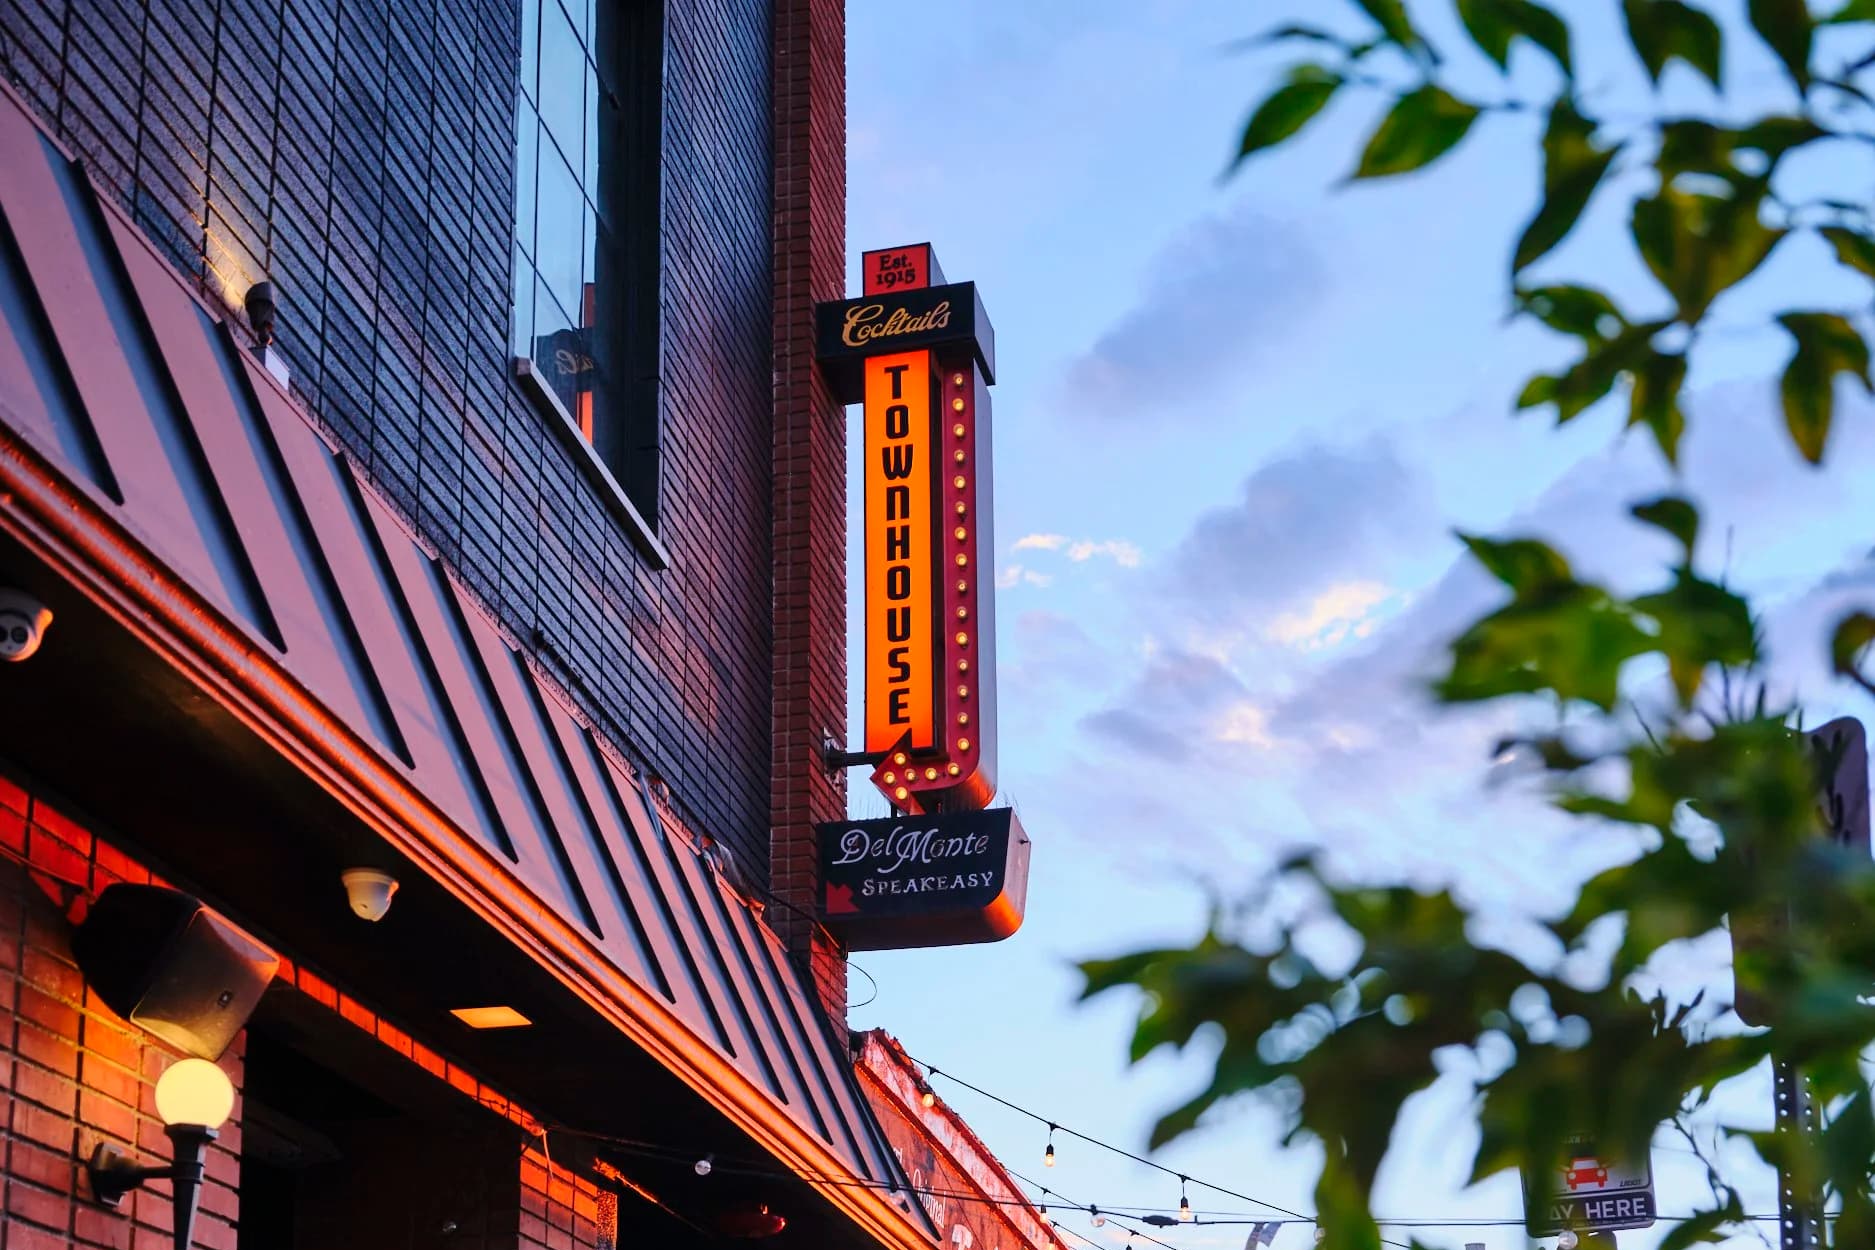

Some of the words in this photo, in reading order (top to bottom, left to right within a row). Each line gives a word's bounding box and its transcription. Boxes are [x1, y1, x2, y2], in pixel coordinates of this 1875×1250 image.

[879, 253, 913, 271] Est.
[876, 267, 916, 289] 1915
[842, 301, 951, 347] Cocktails
[882, 364, 914, 725] TOWNHOUSE
[861, 871, 994, 897] SPEAKEASY
[1584, 1198, 1647, 1219] HERE
